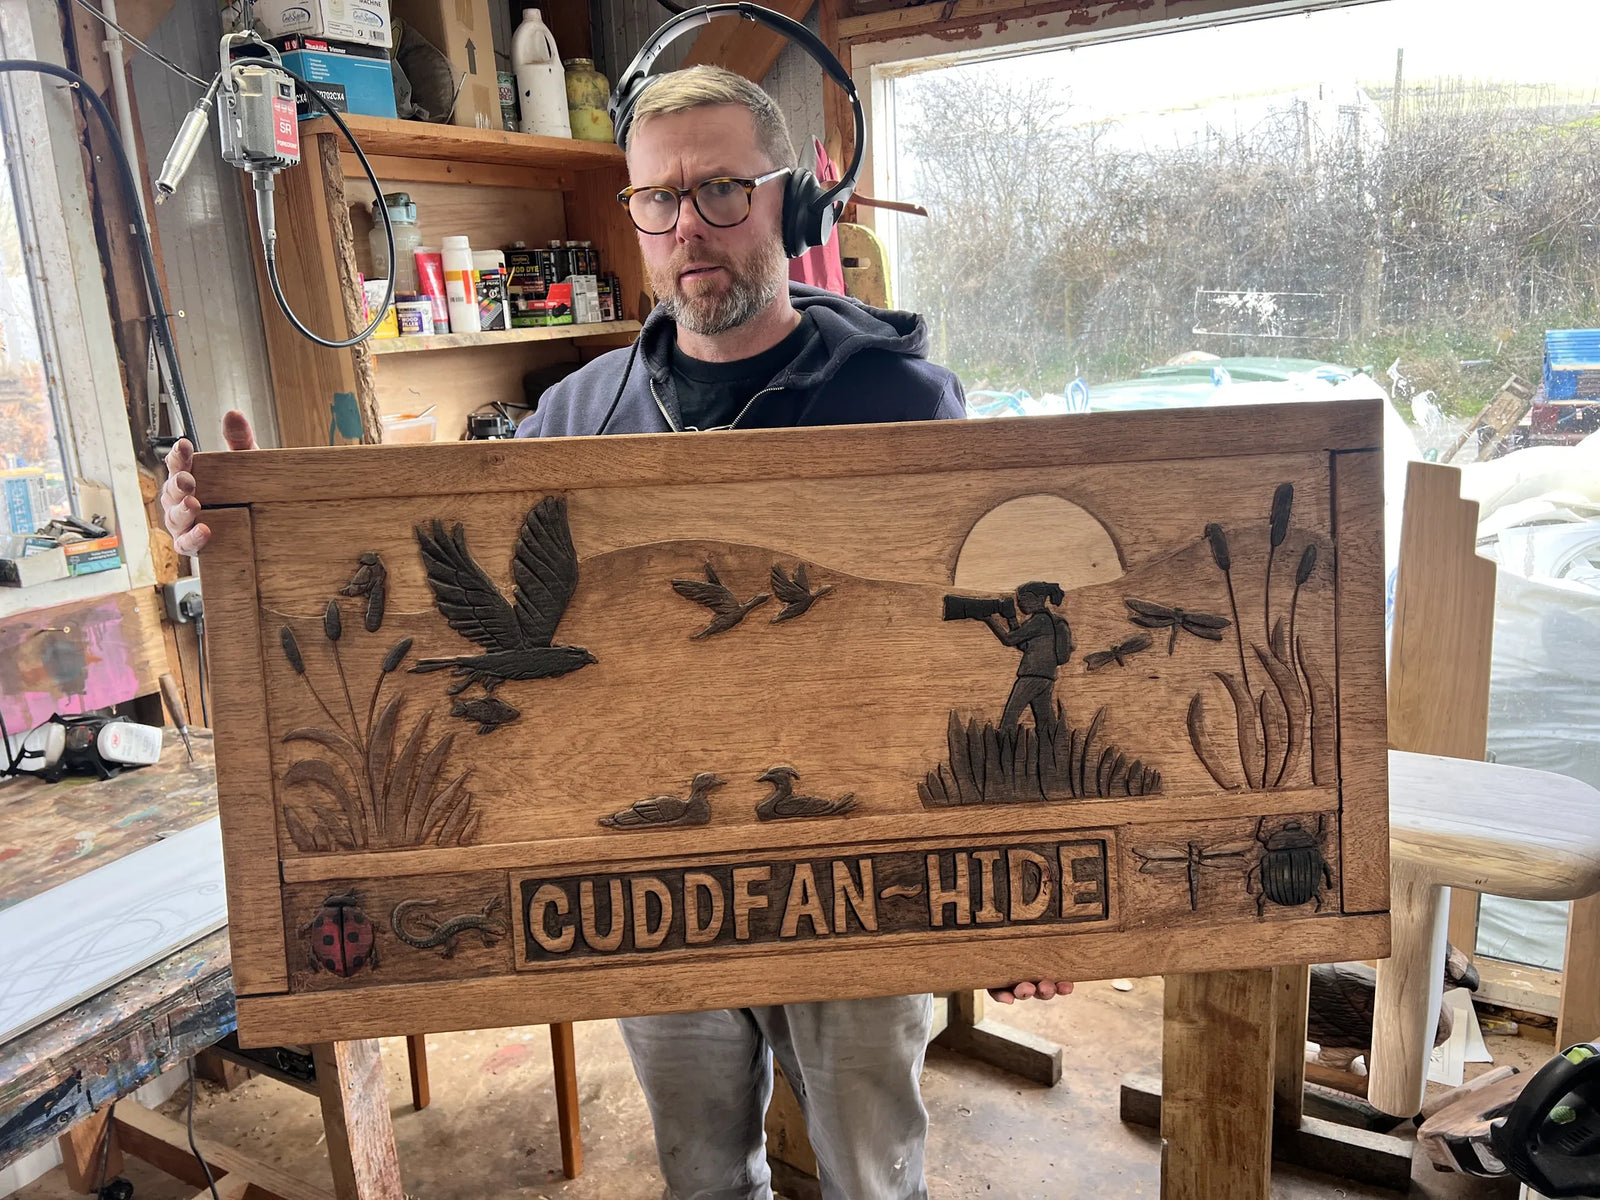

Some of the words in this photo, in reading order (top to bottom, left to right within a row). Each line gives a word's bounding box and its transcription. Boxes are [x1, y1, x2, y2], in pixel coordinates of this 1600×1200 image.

[279, 122, 292, 135] SR
[529, 858, 879, 953] CUDDFAN
[925, 842, 1104, 927] HIDE
